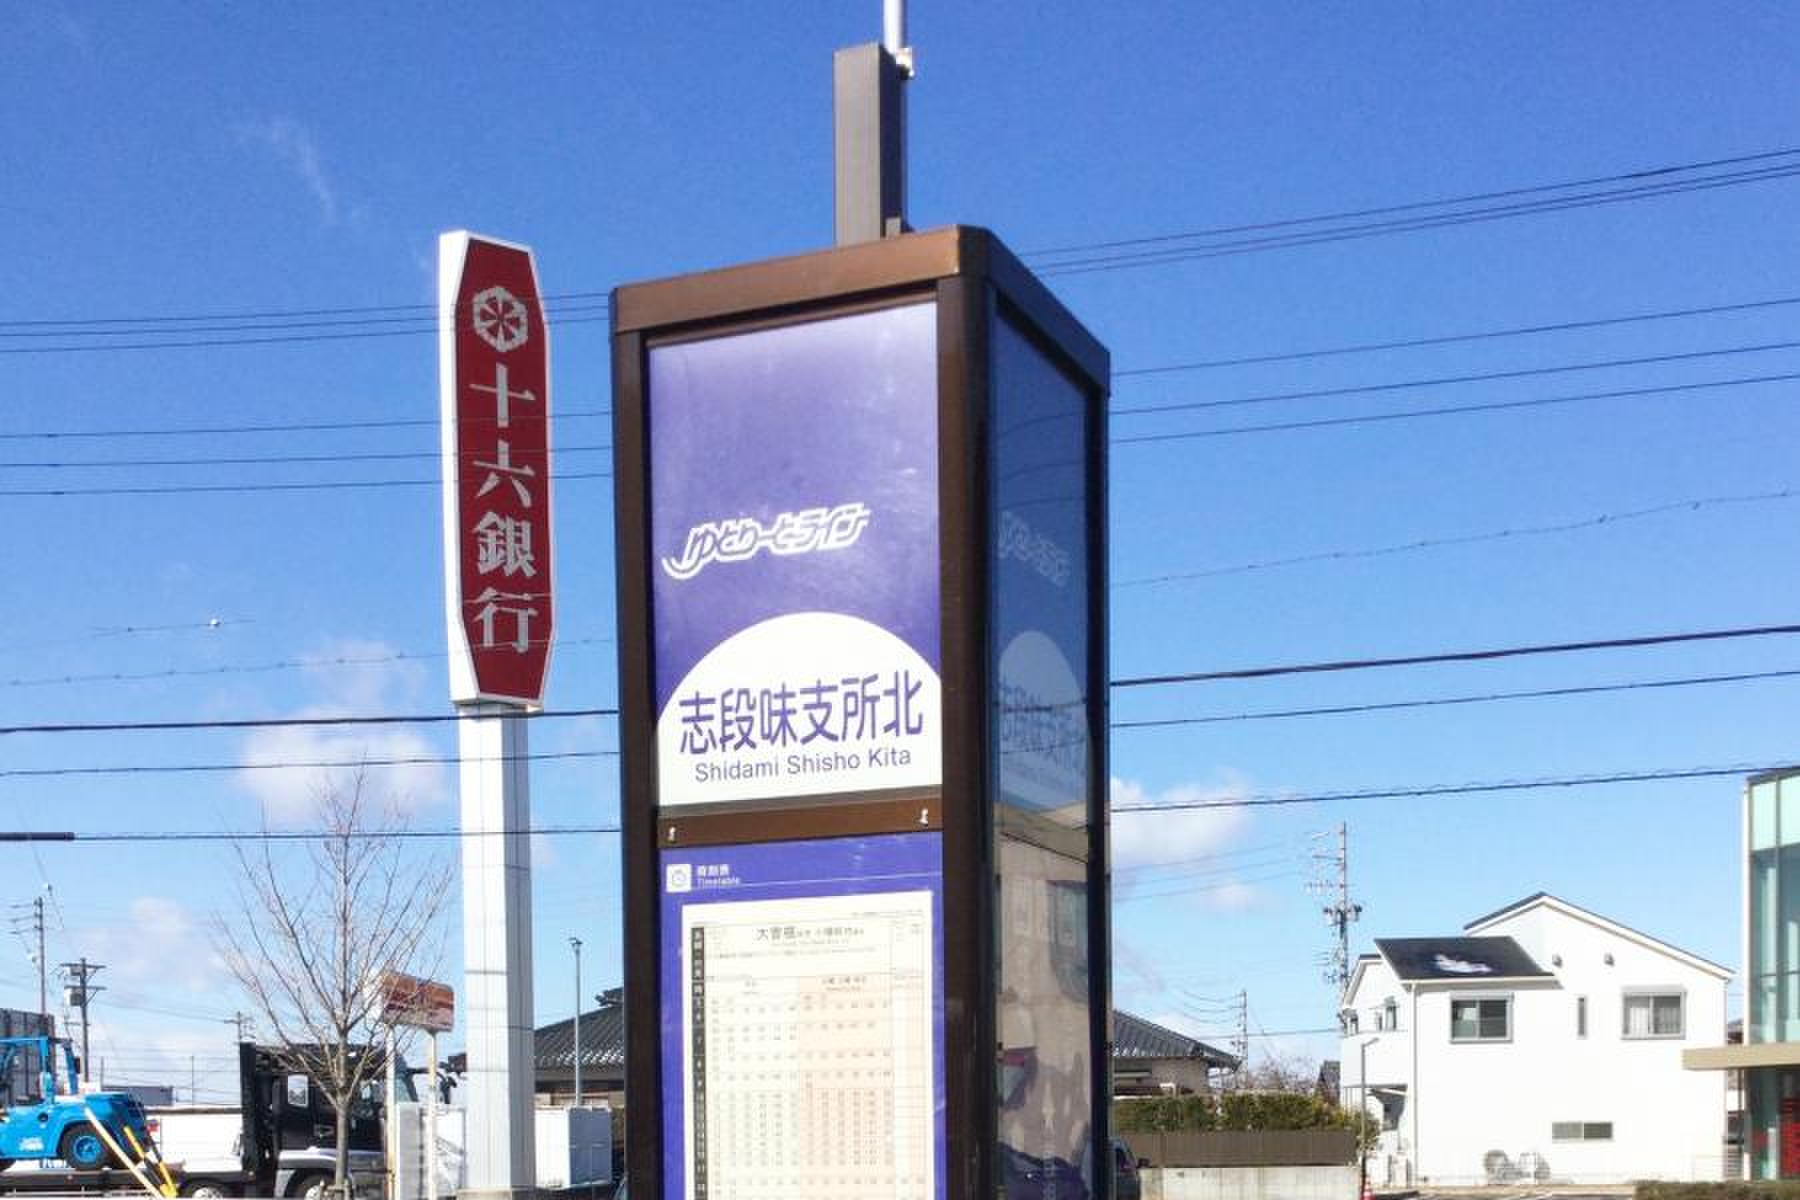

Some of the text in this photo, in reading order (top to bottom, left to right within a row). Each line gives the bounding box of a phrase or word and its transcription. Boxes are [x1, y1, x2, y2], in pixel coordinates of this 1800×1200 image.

[469, 362, 537, 654] 十六銀行
[679, 669, 924, 755] 志段味支所北
[695, 746, 912, 783] Shidami Shisho Kita
